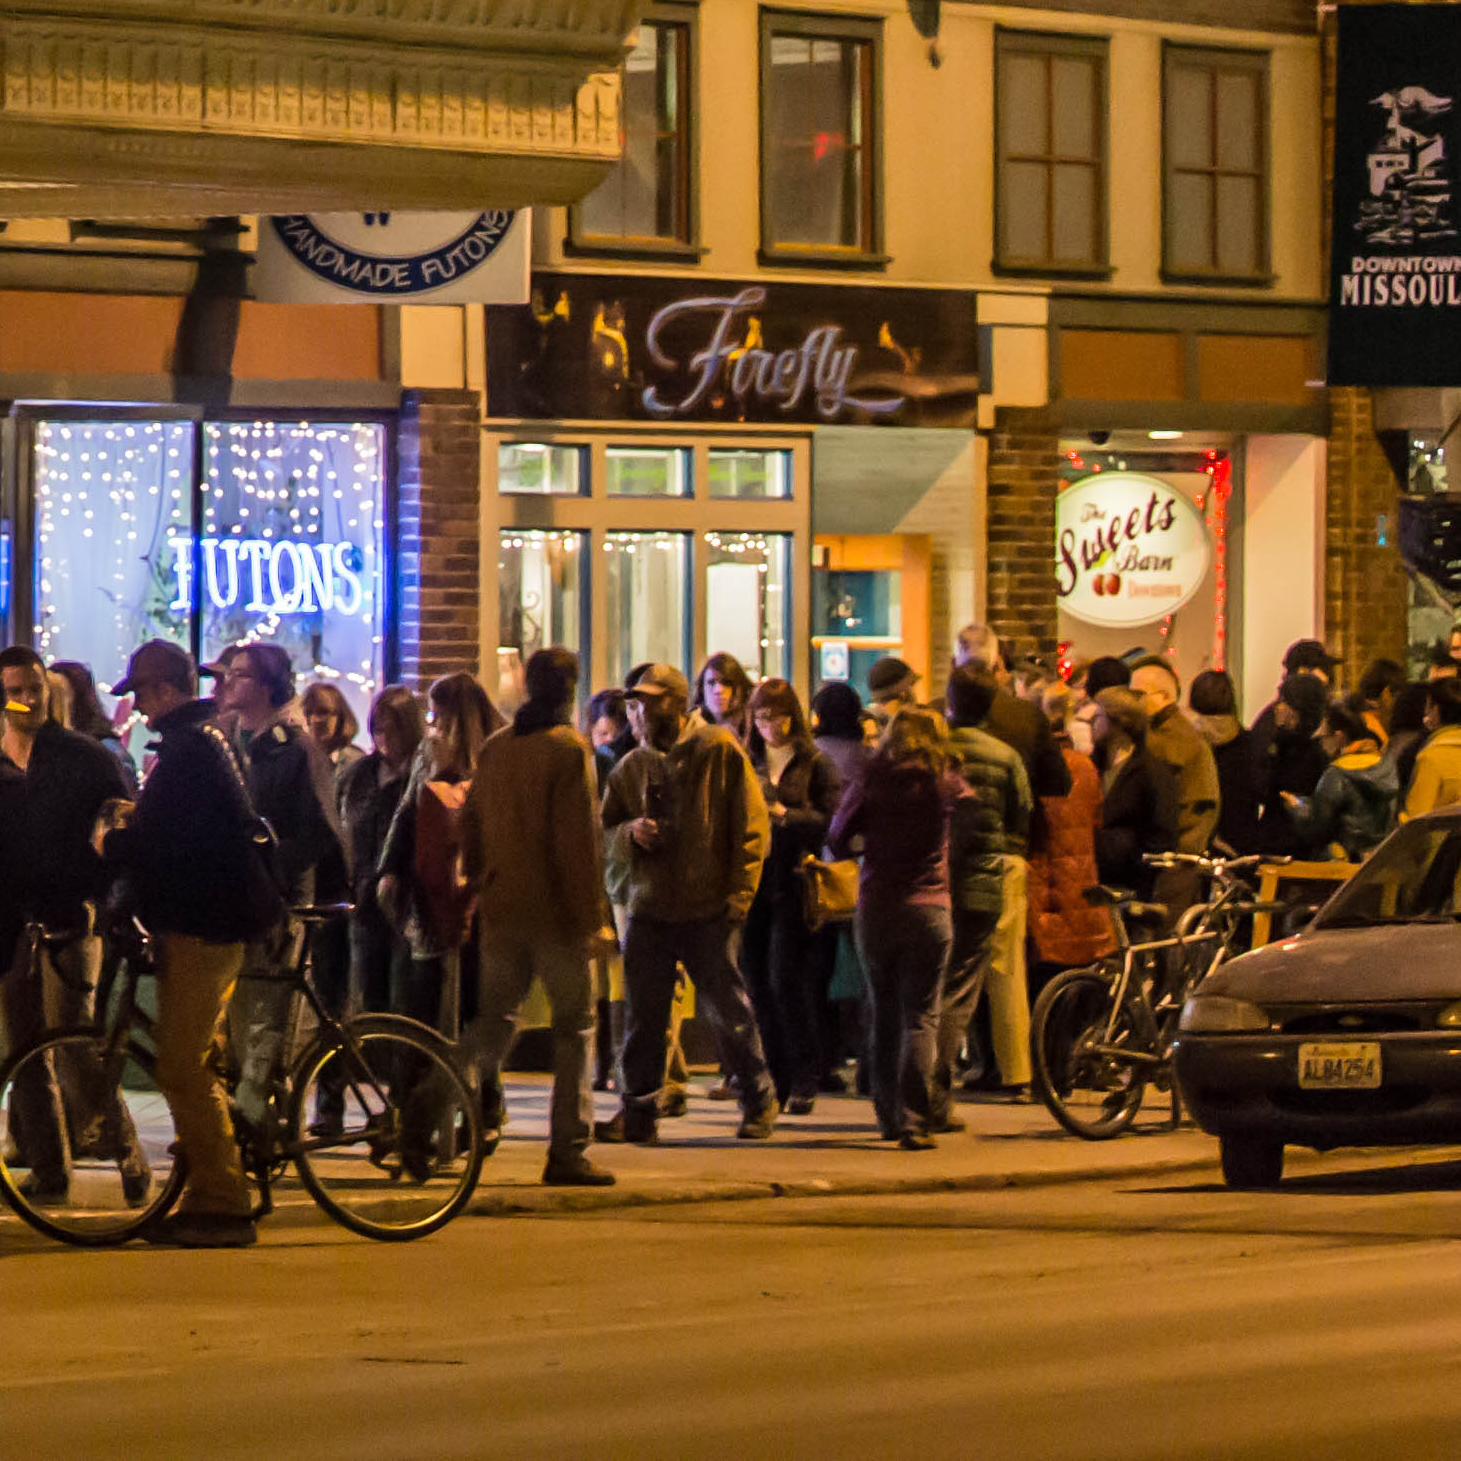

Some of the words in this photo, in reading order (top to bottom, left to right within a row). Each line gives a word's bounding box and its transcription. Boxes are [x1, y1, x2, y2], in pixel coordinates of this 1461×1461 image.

[421, 209, 510, 285] FUTONS
[1340, 274, 1461, 307] MISSOUL
[643, 286, 906, 416] Firefly
[1056, 491, 1176, 597] Sweets
[1117, 544, 1174, 572] Barn
